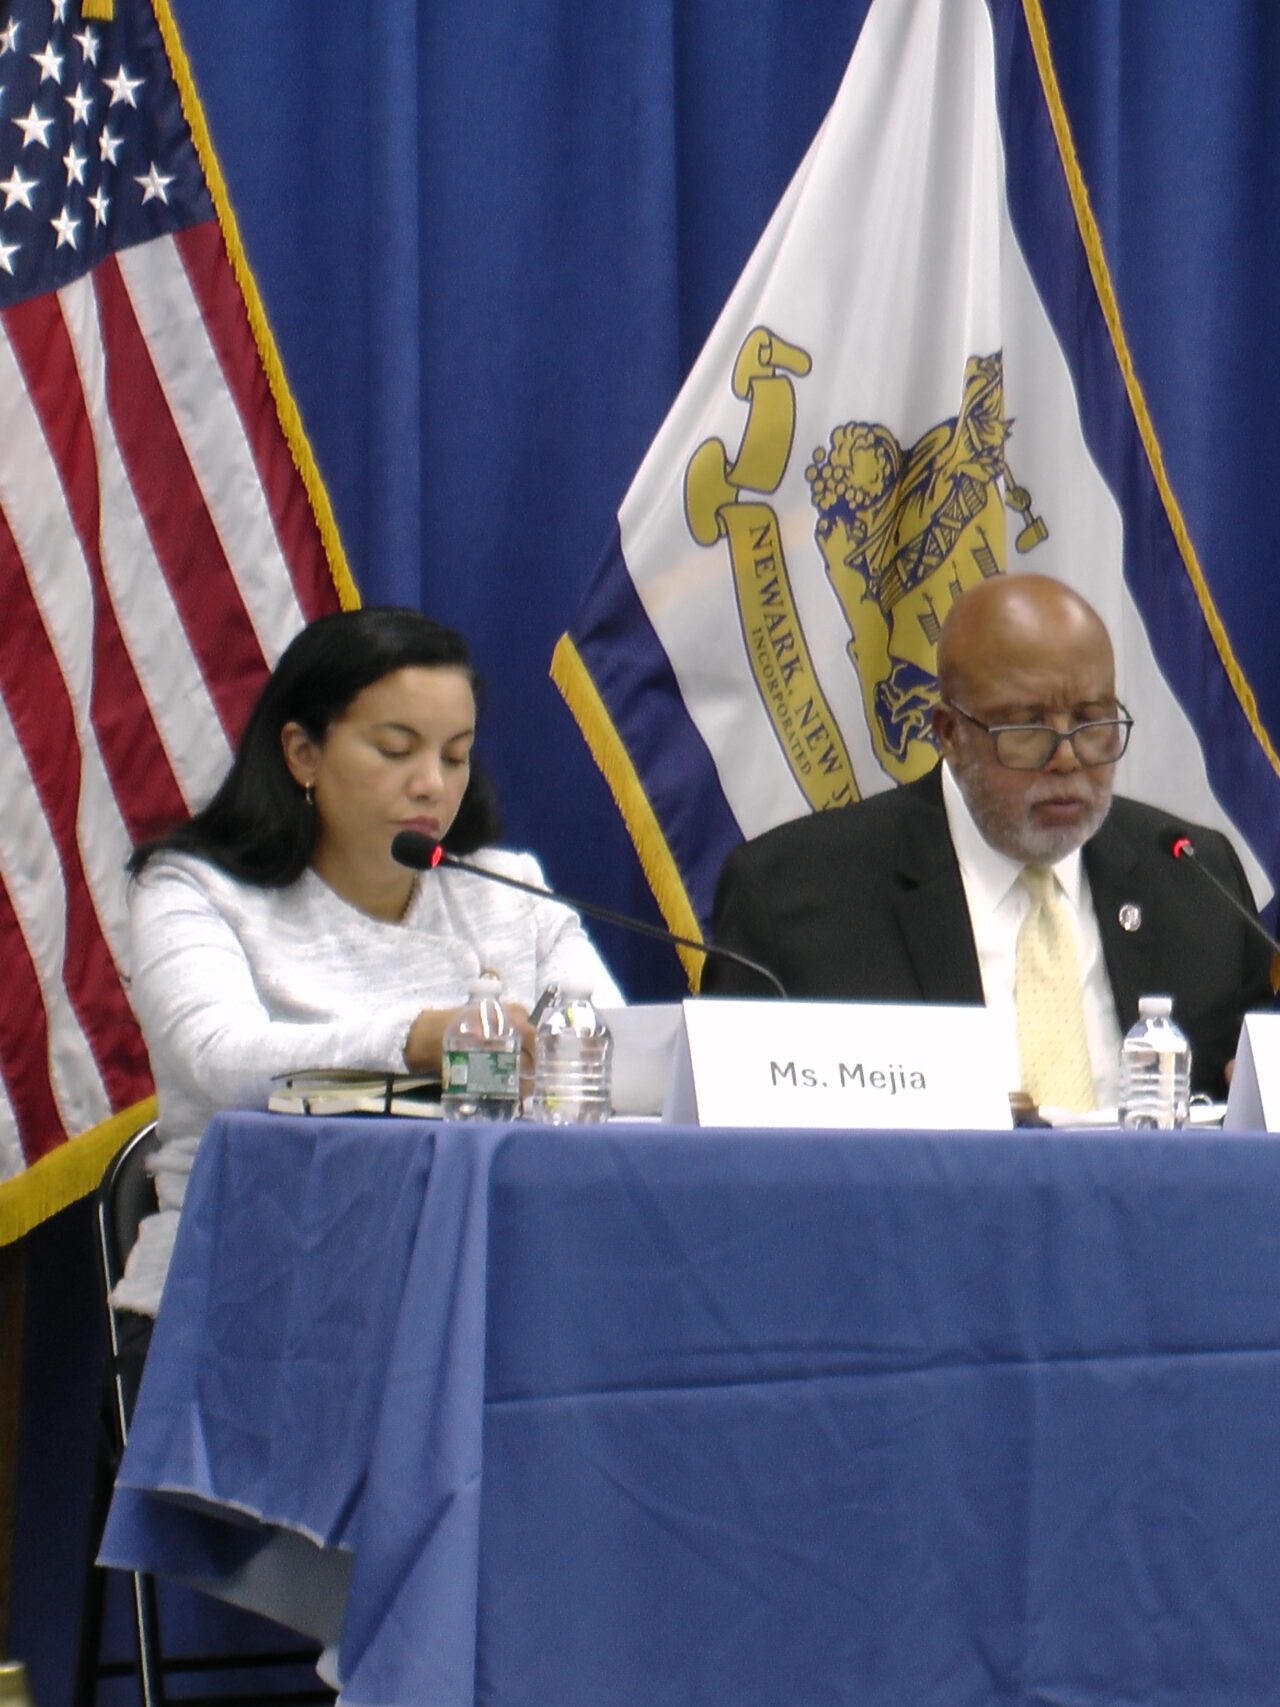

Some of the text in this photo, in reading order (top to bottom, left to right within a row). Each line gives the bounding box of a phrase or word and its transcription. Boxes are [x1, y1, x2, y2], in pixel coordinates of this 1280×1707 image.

[752, 626, 813, 775] INCORPORATED
[794, 697, 844, 776] NEW
[770, 1061, 927, 1096] Ms. Mejia
